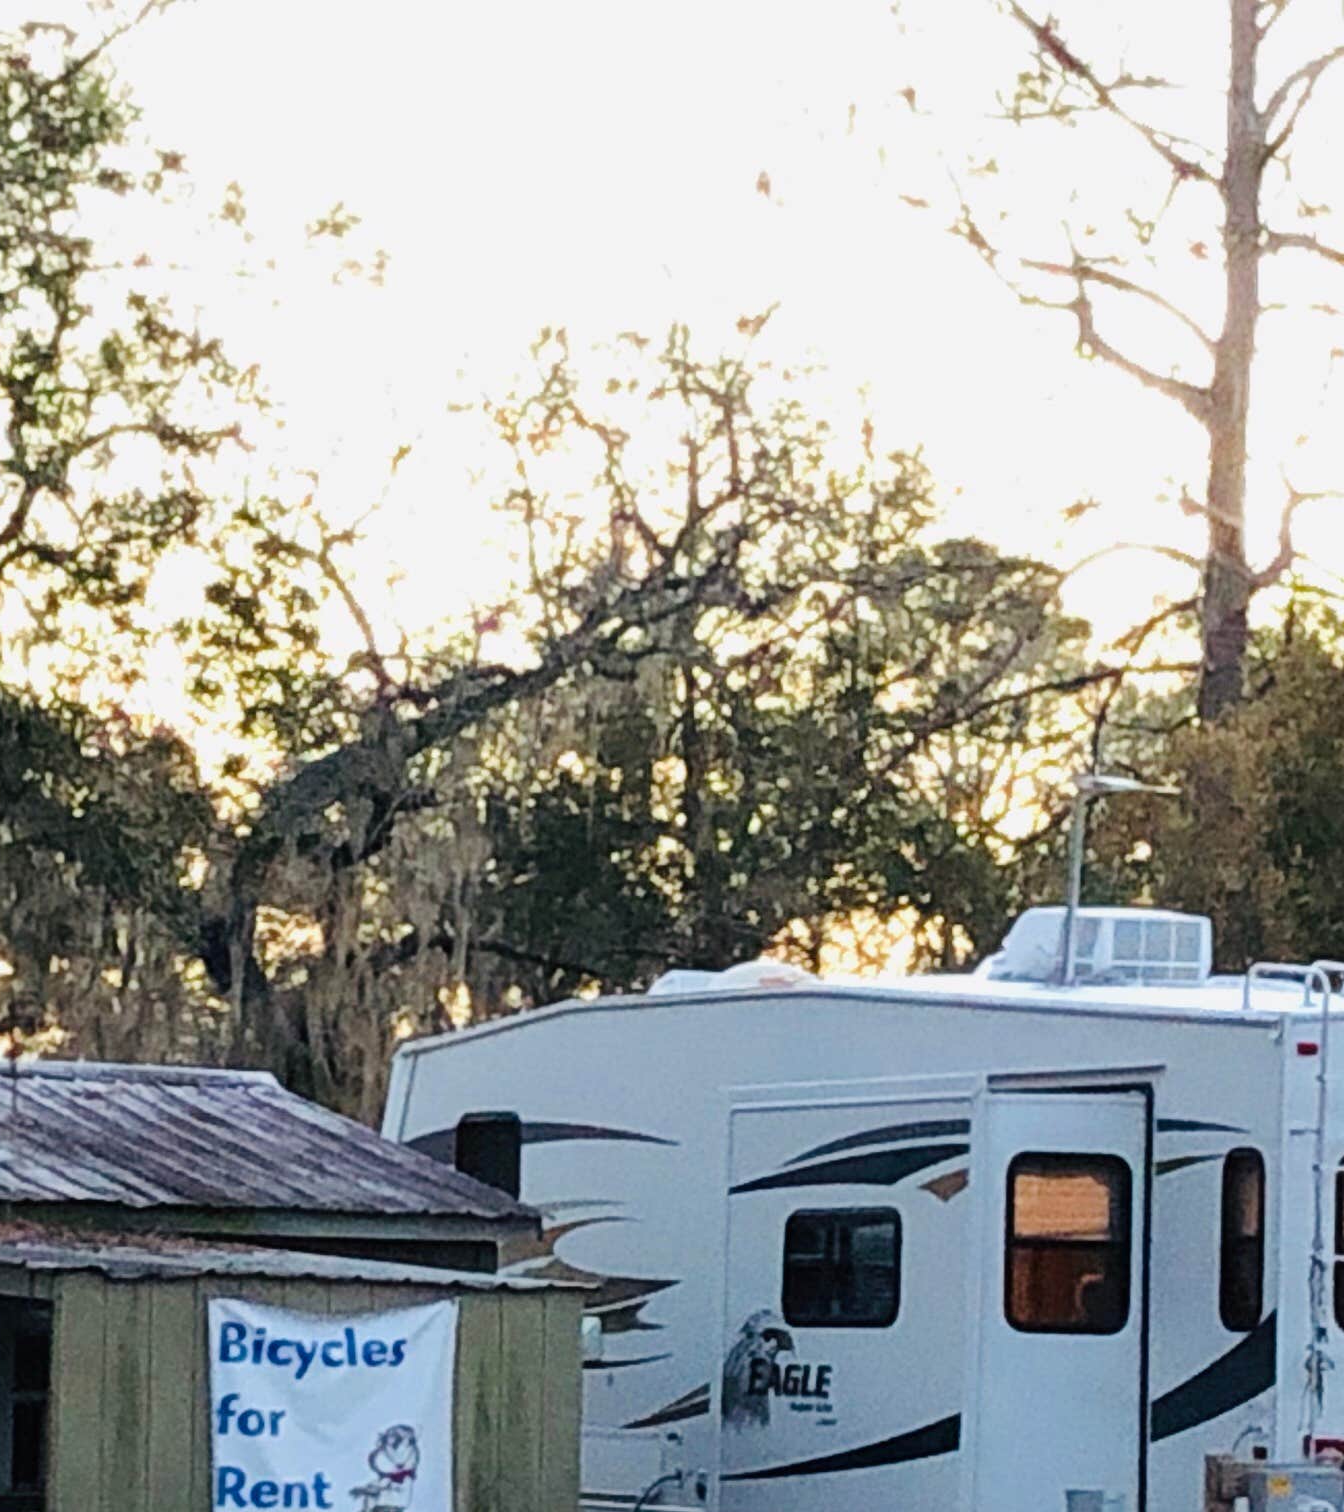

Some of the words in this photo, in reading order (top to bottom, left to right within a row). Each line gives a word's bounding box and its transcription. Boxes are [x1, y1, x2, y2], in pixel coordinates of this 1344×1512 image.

[218, 1321, 408, 1380] Bicycles
[747, 1357, 833, 1399] EAGLE
[216, 1392, 286, 1436] for
[215, 1465, 334, 1509] Rent
